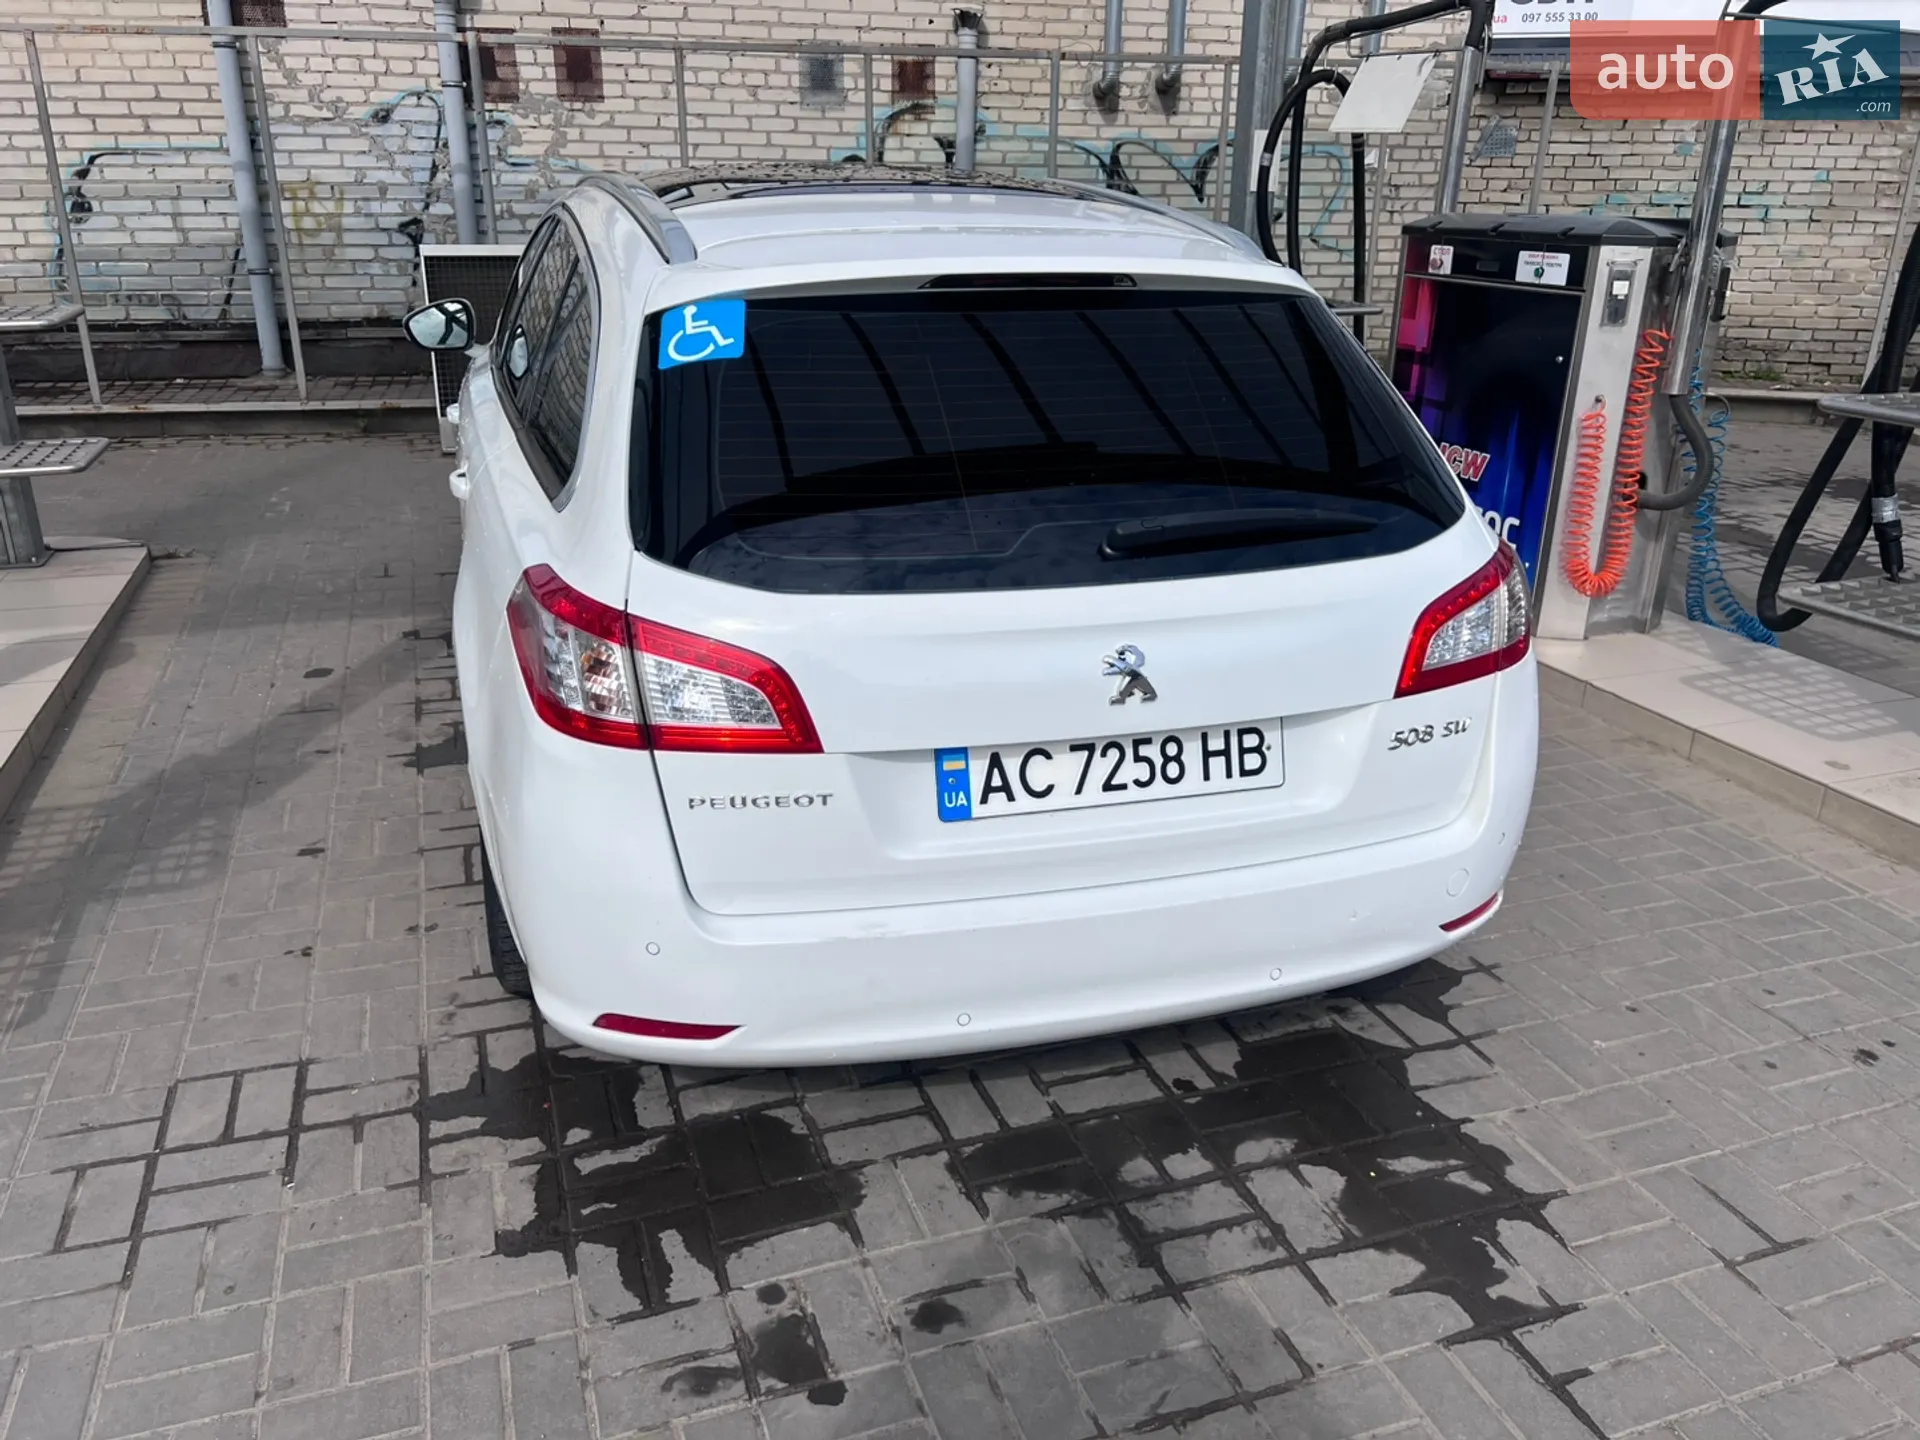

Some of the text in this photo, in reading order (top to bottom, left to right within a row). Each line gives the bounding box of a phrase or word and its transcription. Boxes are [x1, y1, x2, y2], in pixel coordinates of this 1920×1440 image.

[1522, 12, 1598, 22] 097 555 33 00
[1387, 716, 1472, 750] 508 SW
[979, 726, 1268, 805] AC 7258 HB
[688, 793, 833, 810] PEUGEOT
[944, 790, 968, 808] UA
